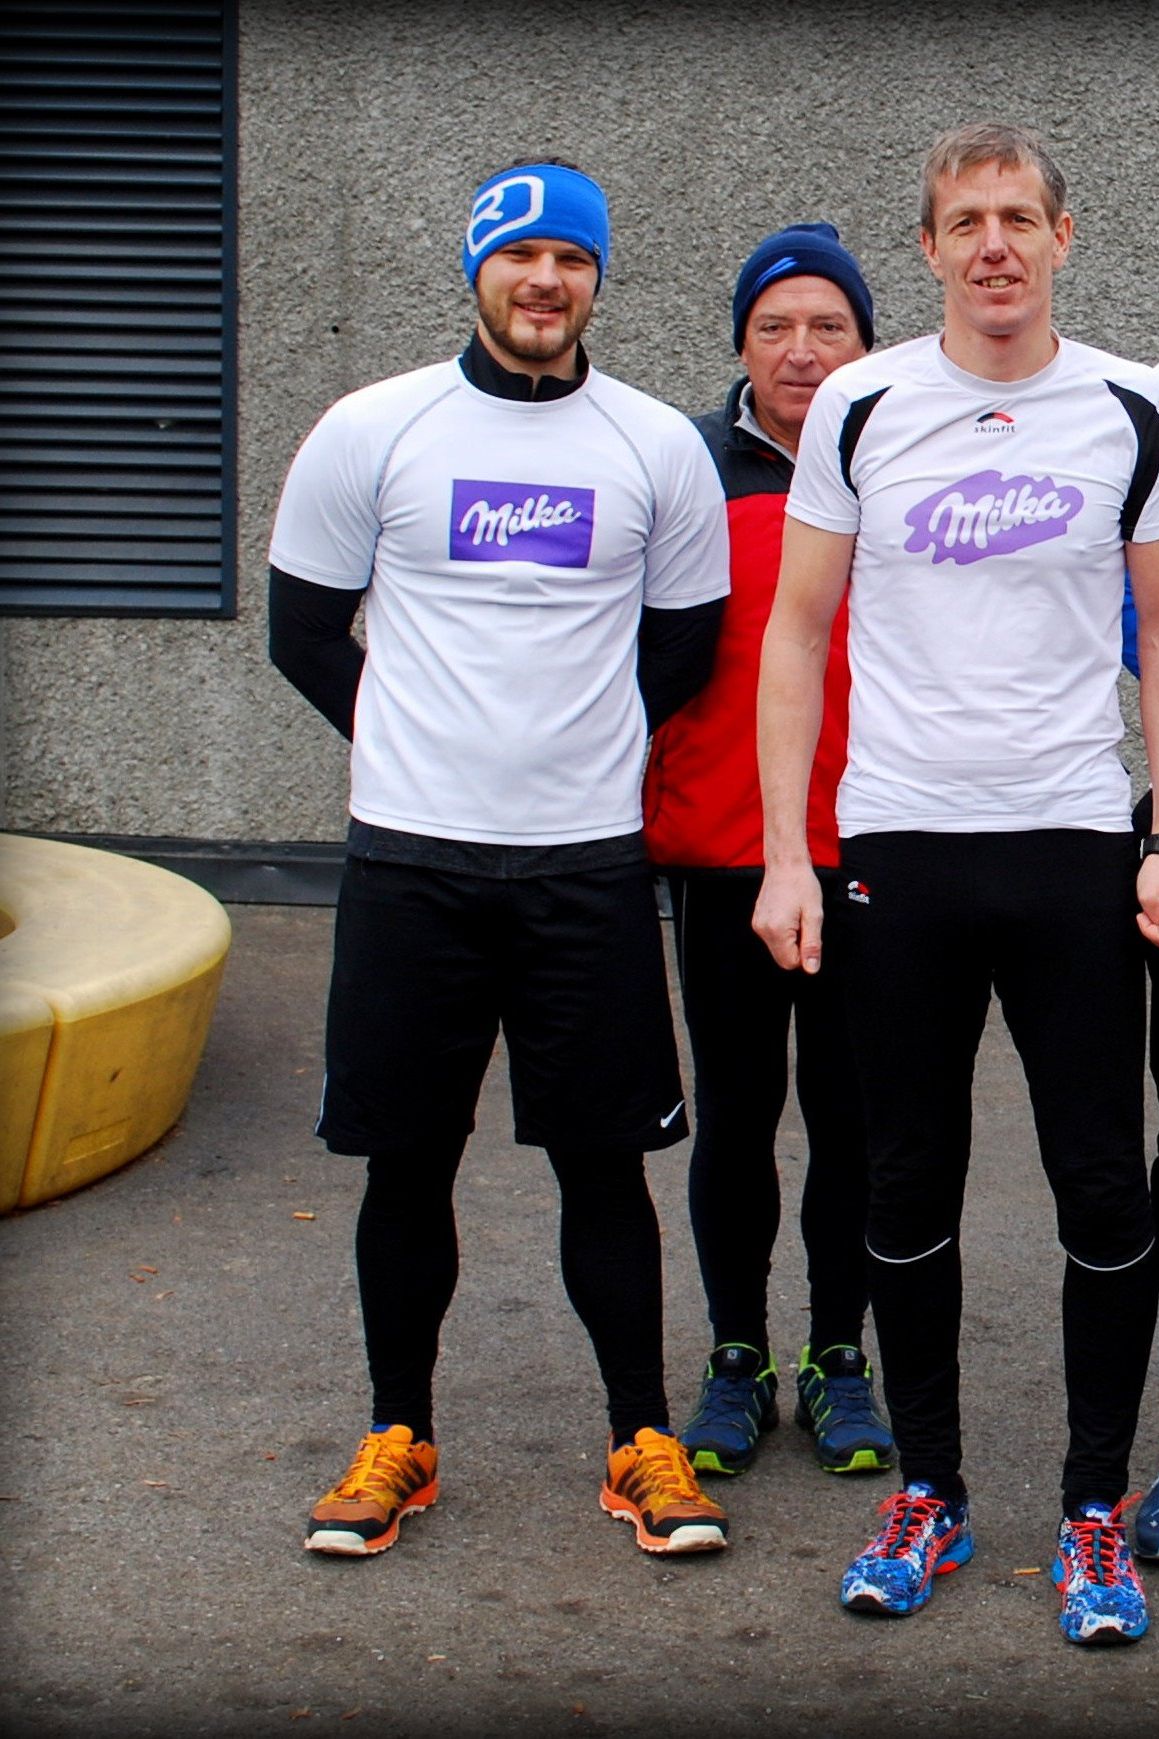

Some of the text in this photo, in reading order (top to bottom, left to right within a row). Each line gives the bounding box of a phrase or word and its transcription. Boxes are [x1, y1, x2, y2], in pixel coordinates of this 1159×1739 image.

[973, 424, 1017, 433] skinfit
[459, 494, 582, 547] Milka
[928, 484, 1071, 550] Milka
